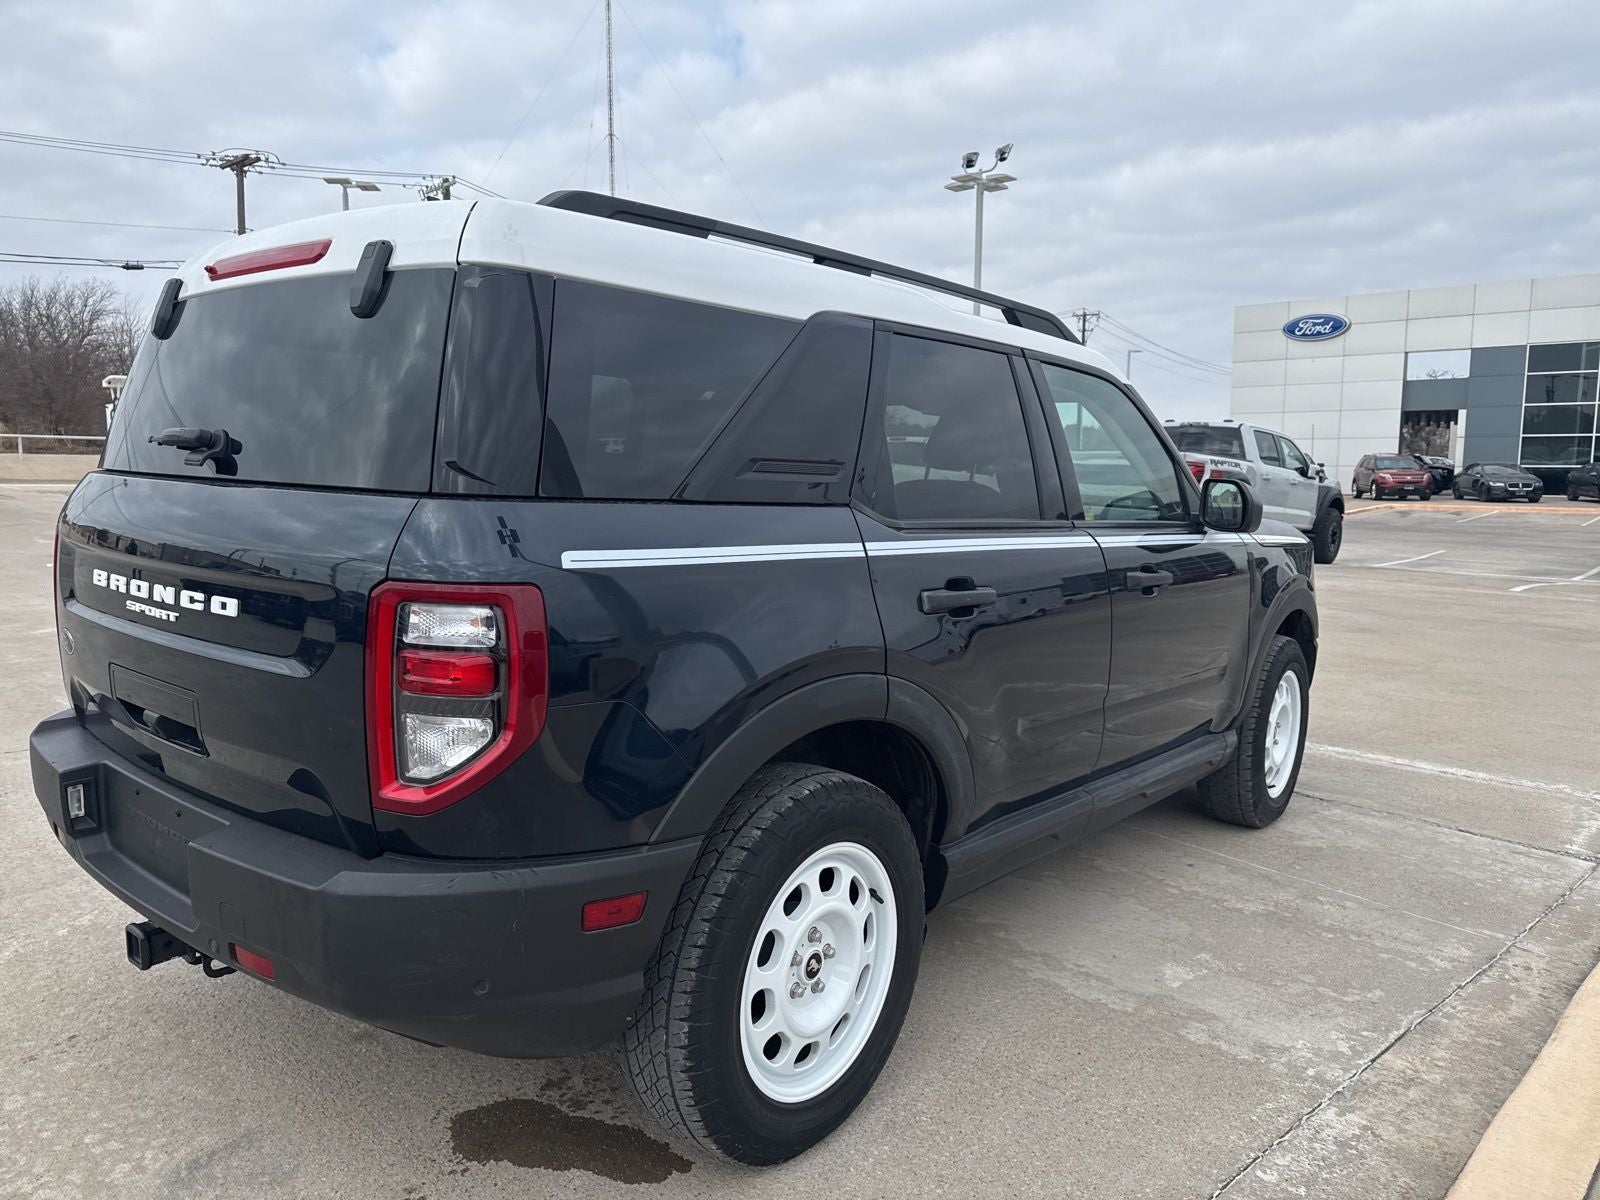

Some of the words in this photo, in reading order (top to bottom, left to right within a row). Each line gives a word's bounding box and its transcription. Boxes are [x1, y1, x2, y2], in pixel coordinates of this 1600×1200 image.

[1294, 318, 1334, 336] Ford
[1209, 458, 1243, 471] RAPTOR
[92, 568, 240, 618] BRONCO
[125, 600, 180, 622] SPORT
